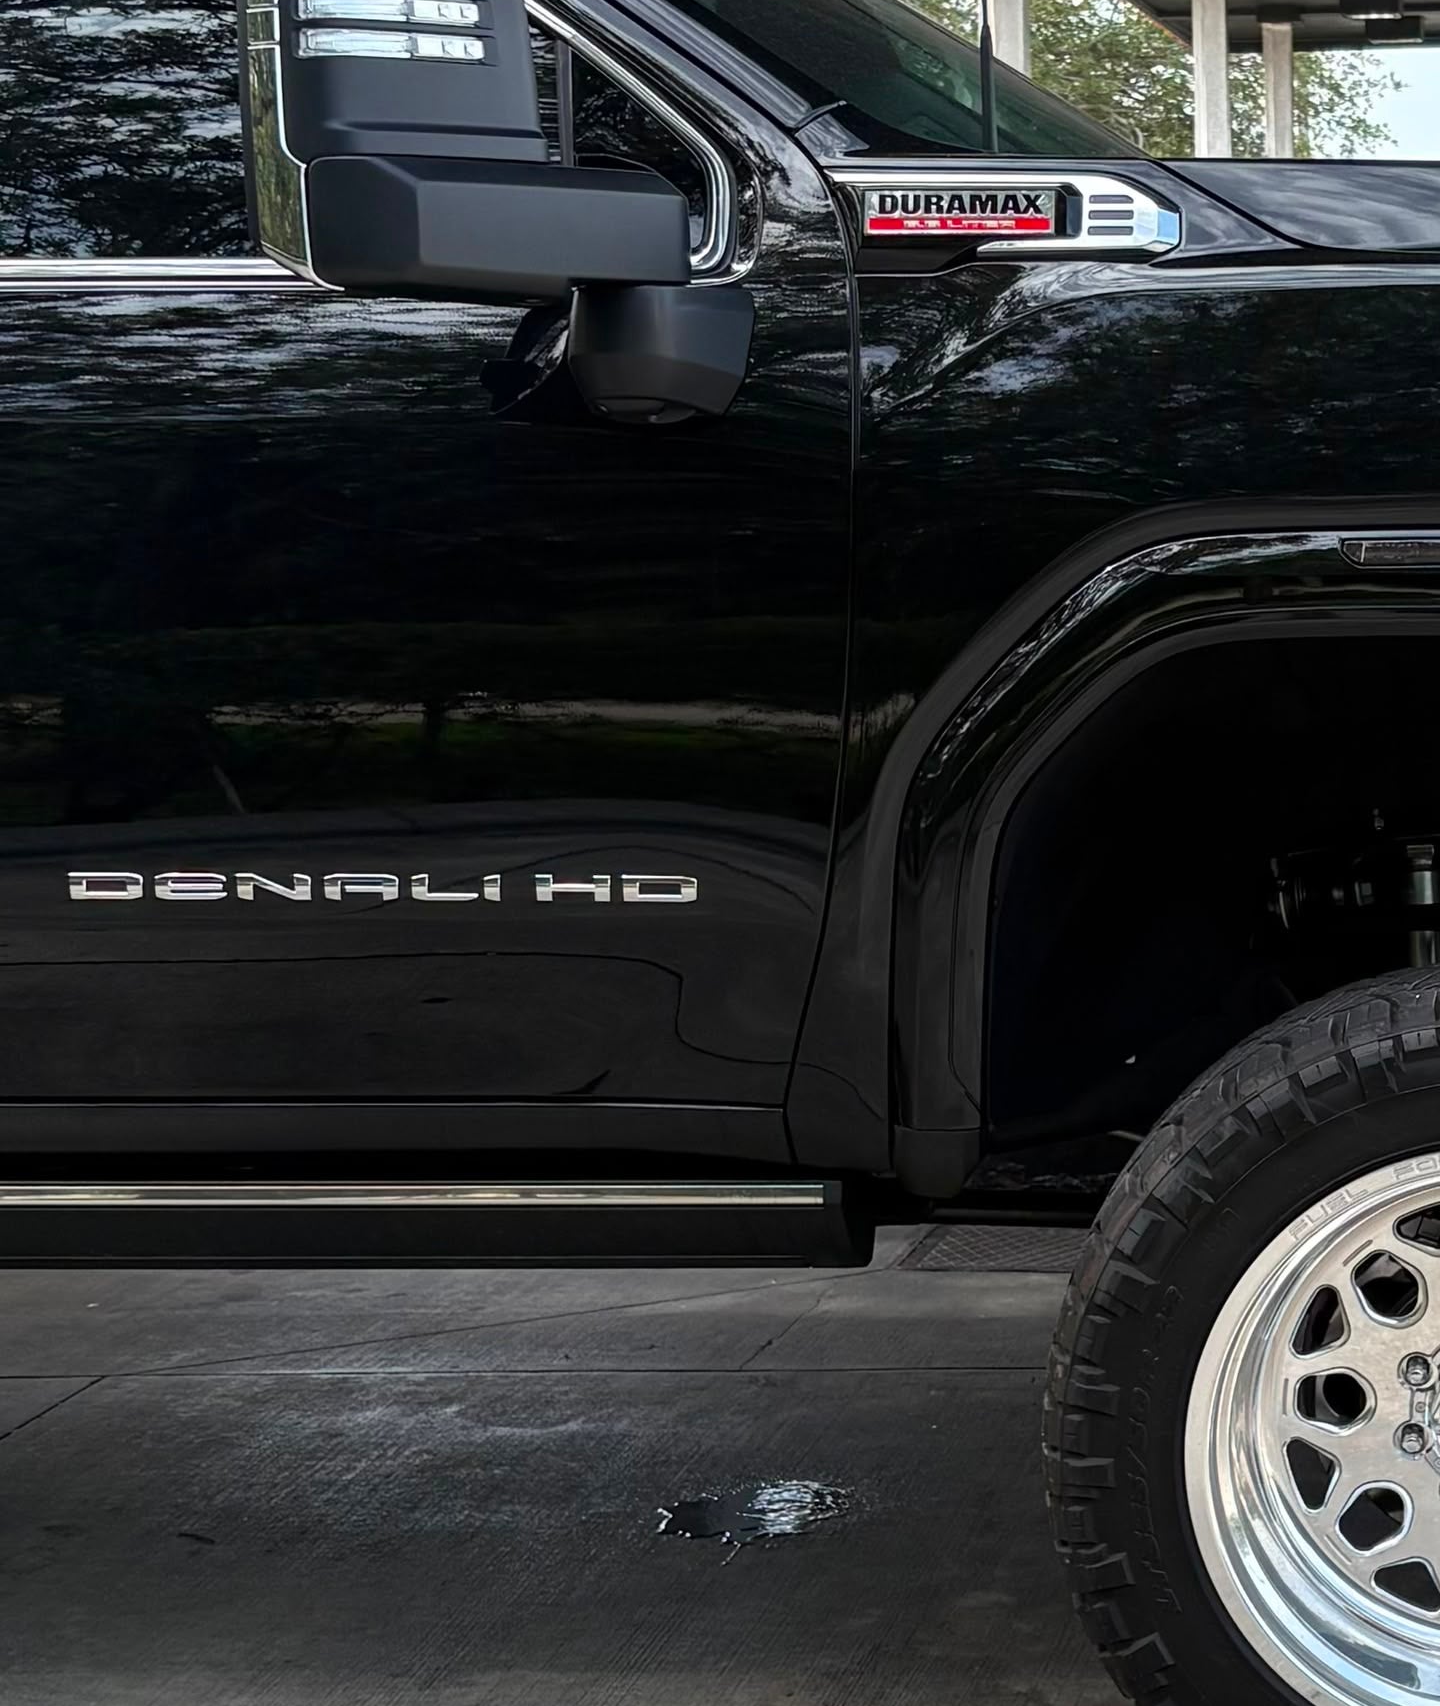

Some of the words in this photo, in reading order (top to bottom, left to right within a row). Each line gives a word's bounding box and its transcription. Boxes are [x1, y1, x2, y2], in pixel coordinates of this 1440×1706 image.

[877, 193, 1044, 215] DURAMAX
[946, 219, 1017, 229] LITER
[67, 871, 501, 903] DENALI
[534, 873, 698, 903] HD
[1287, 1187, 1369, 1241] FUEL
